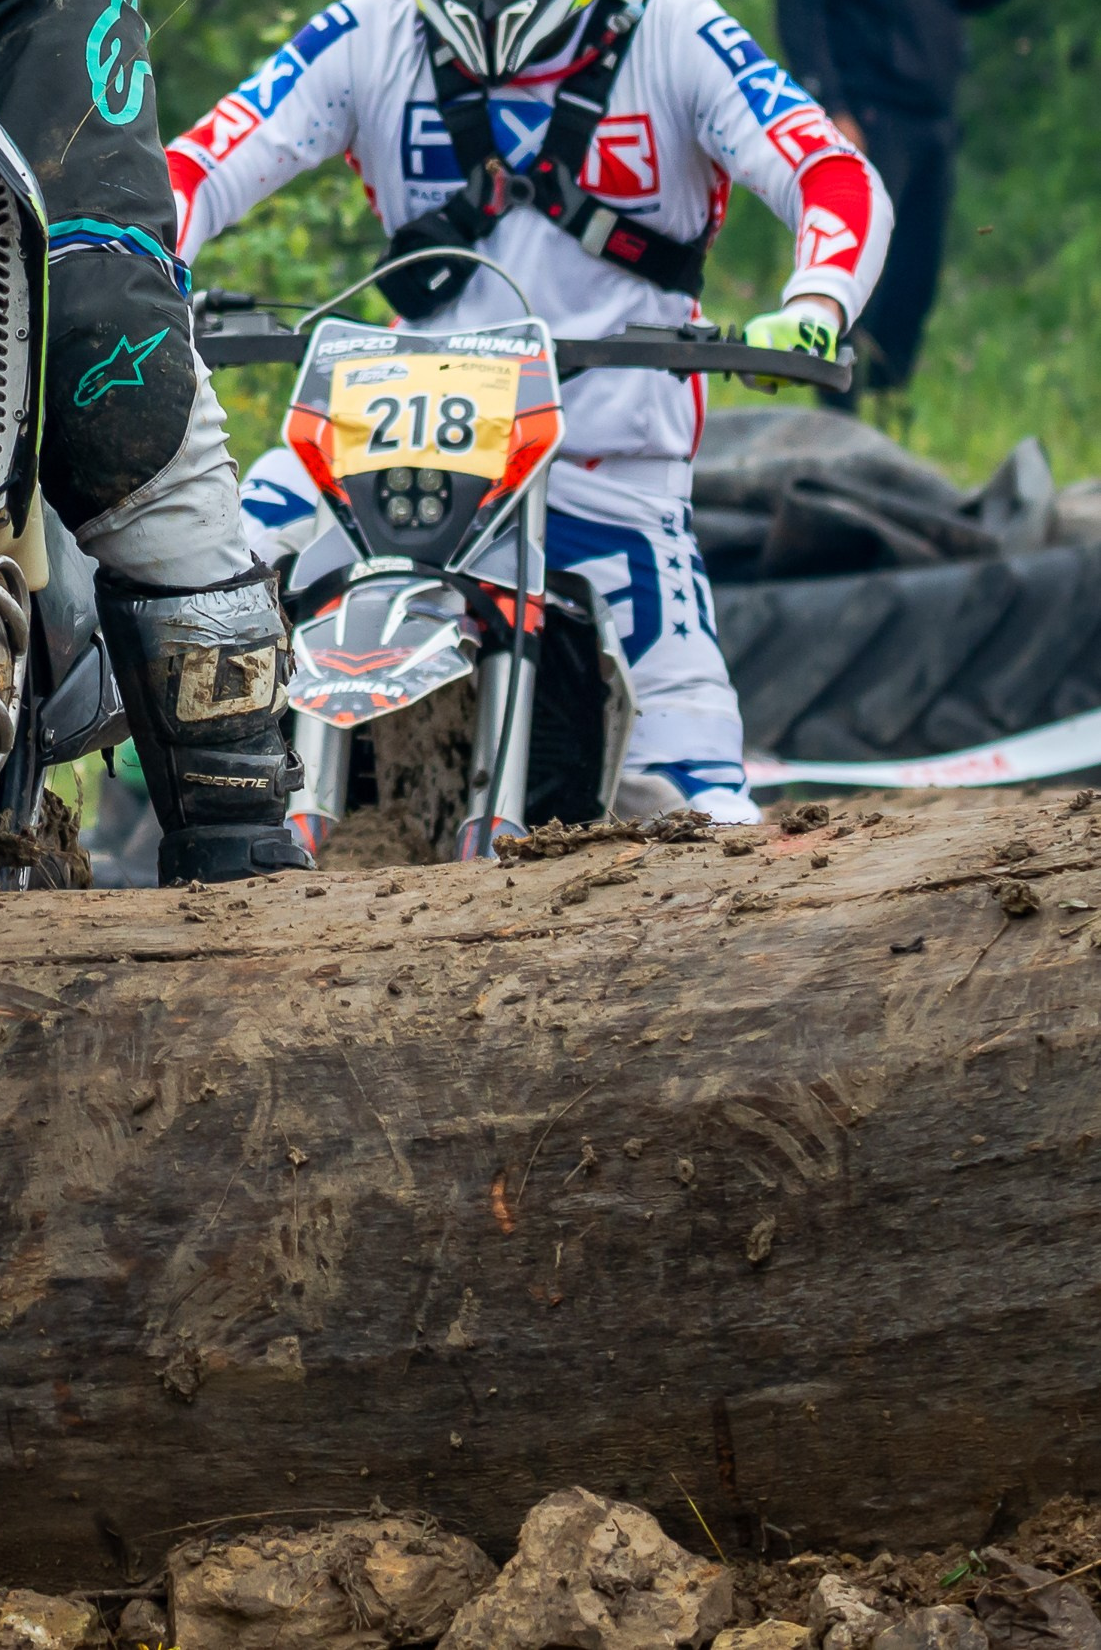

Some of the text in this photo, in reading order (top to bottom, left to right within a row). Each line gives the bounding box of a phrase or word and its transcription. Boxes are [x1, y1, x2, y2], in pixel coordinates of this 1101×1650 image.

[317, 335, 398, 357] RSPZD
[448, 336, 541, 357] КИНЖАЛ
[366, 395, 477, 455] 218
[303, 681, 404, 699] КИНЖАЛ
